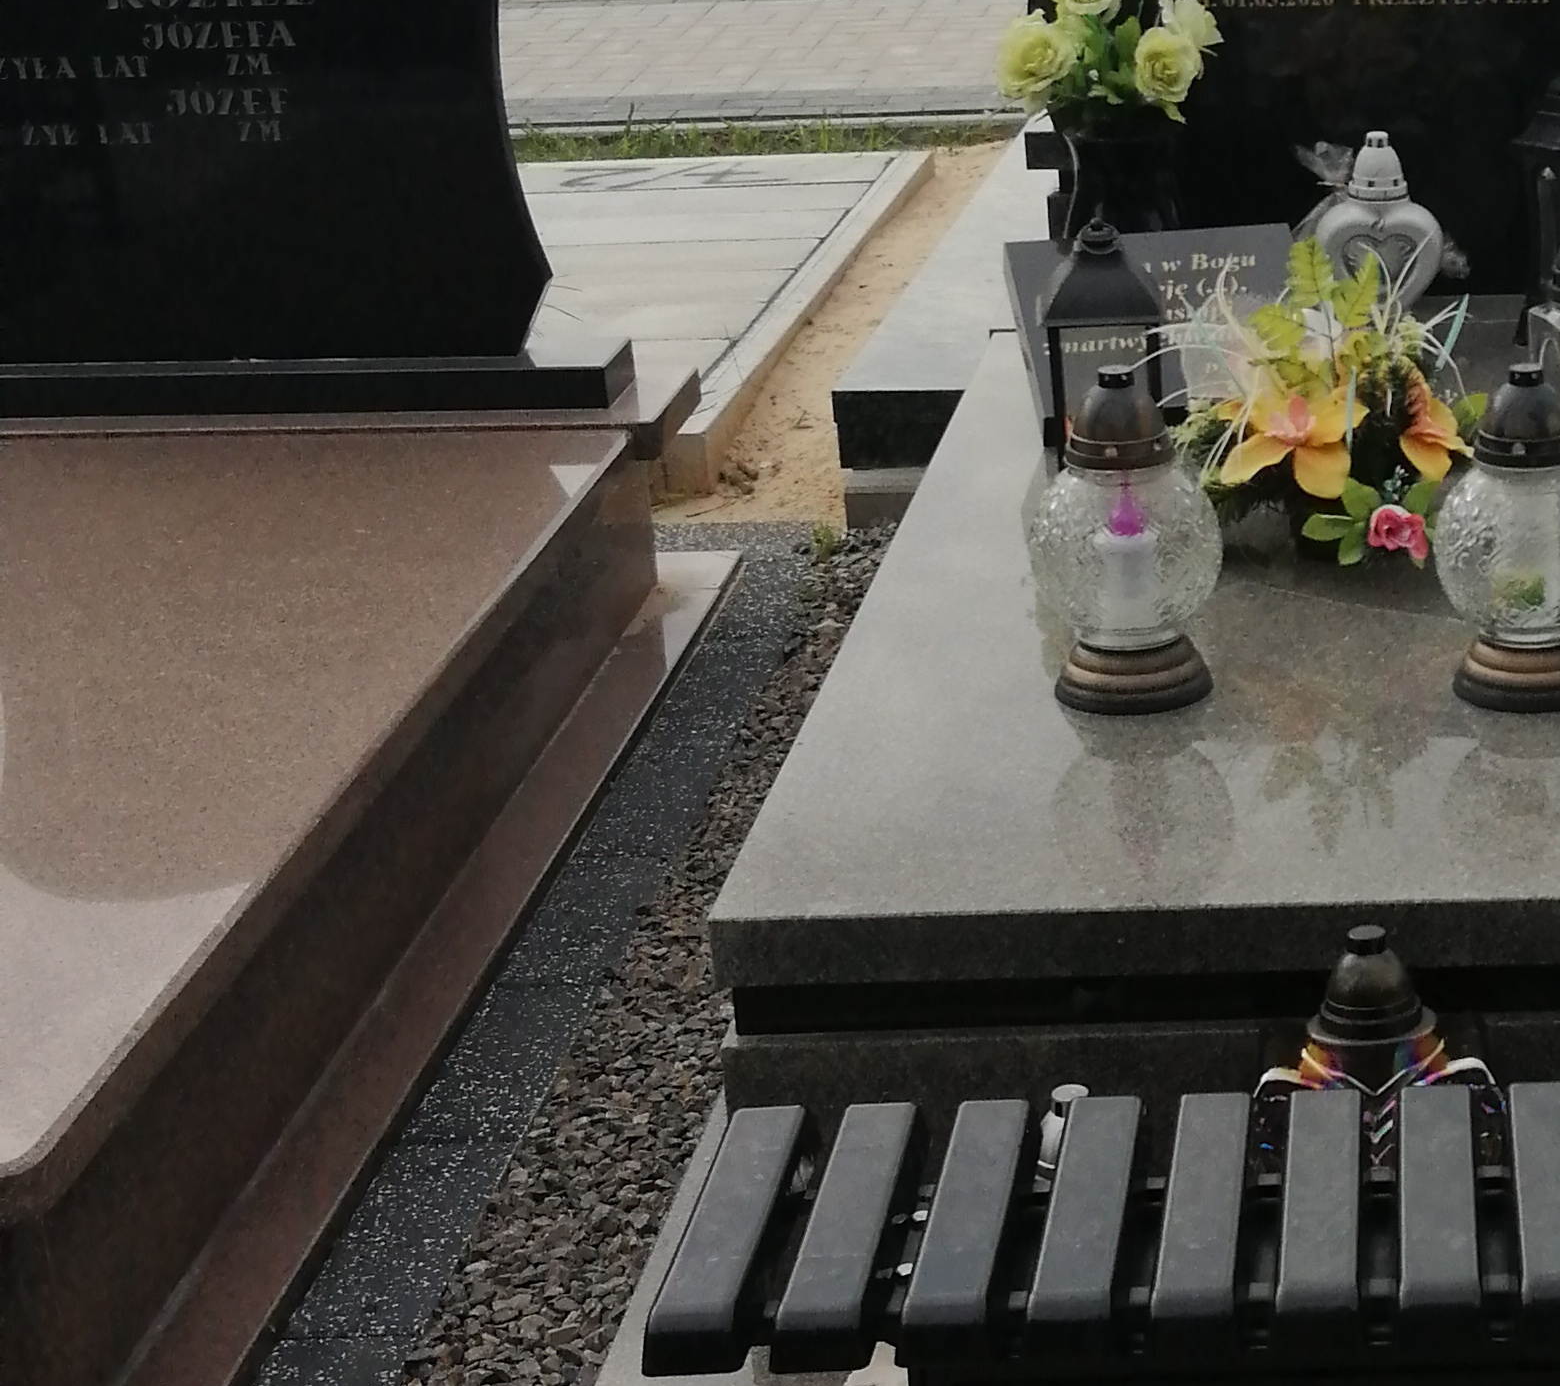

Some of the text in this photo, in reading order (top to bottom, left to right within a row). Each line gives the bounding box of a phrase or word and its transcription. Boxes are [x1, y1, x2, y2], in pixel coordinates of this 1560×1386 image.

[142, 15, 297, 50] JÓZEFA
[91, 55, 149, 78] LAT
[166, 82, 290, 116] JÓZEF
[97, 121, 154, 145] LAT
[1191, 252, 1256, 274] Bogu
